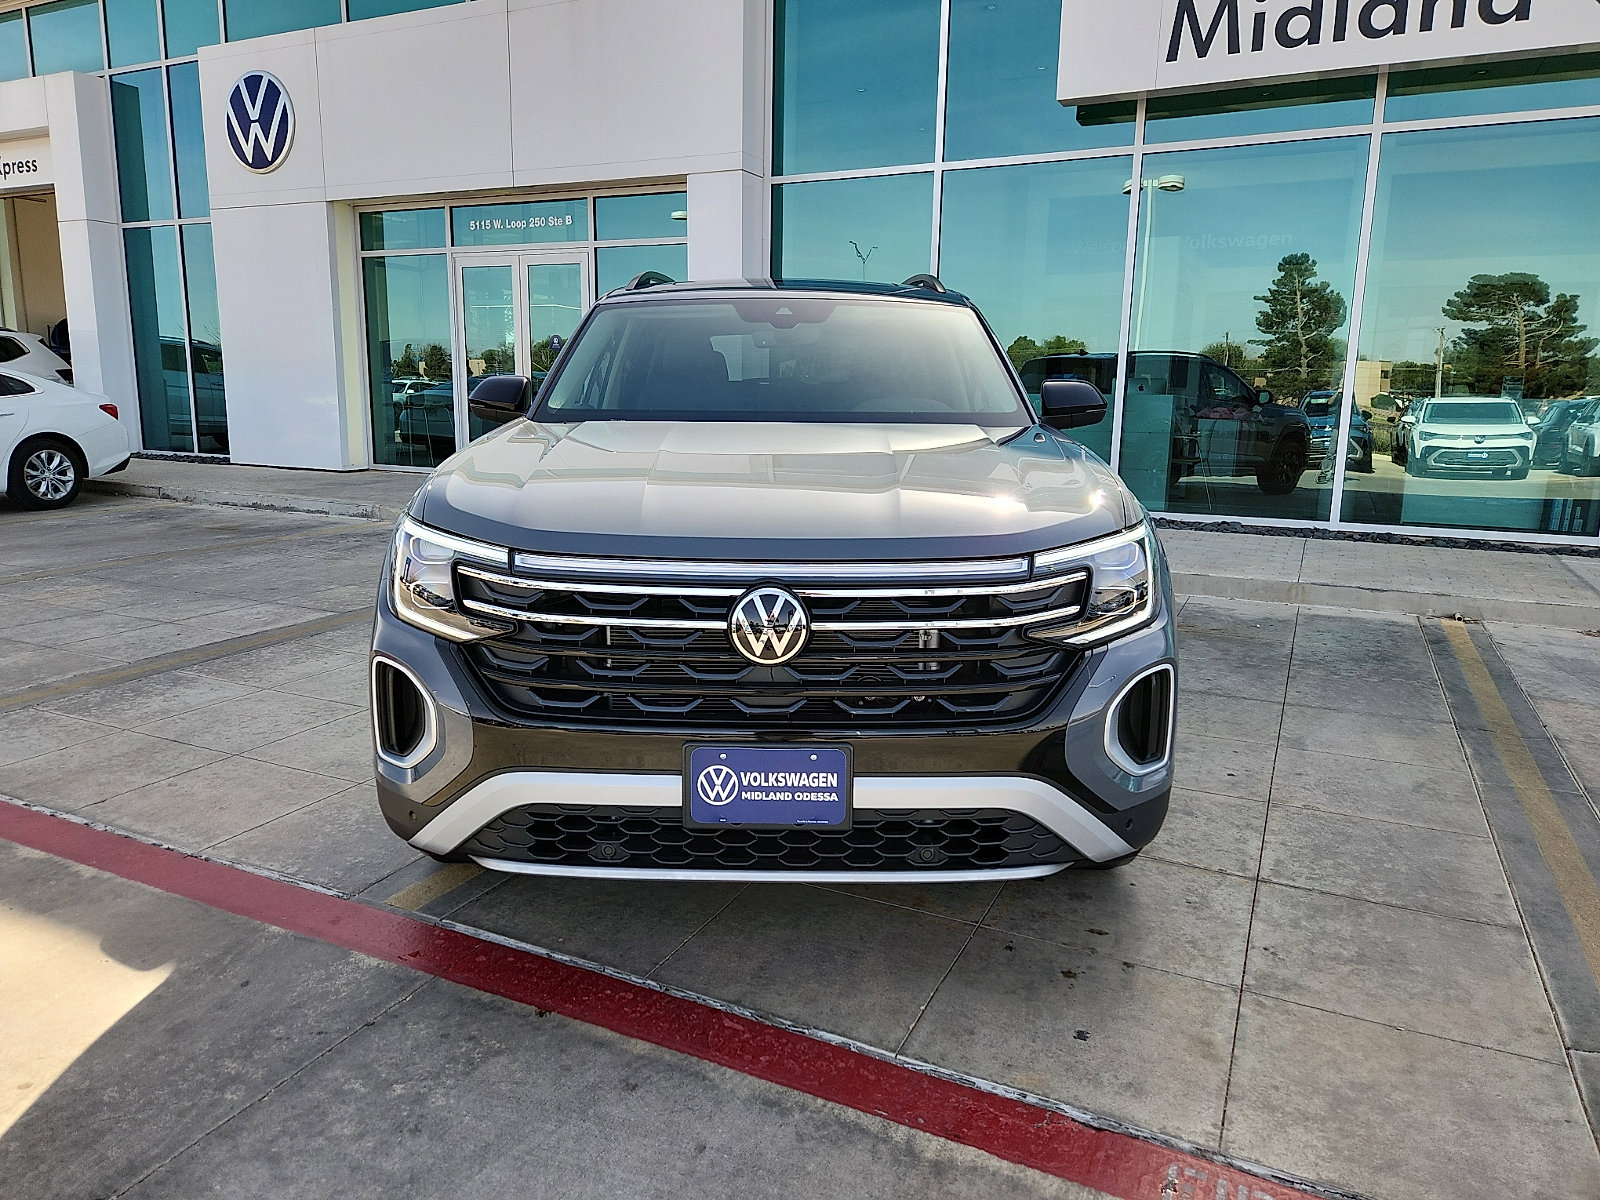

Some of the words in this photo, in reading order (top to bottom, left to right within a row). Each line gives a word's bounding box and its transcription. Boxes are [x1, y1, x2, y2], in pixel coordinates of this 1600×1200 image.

[470, 220, 491, 231] 5115
[493, 219, 504, 229] W.
[506, 218, 527, 230] Loop
[529, 217, 546, 228] 250
[548, 216, 563, 226] Ste
[565, 215, 573, 225] B
[740, 771, 838, 788] VOLKSWAGEN
[741, 791, 793, 801] MIDLAND
[795, 792, 839, 802] ODESSA
